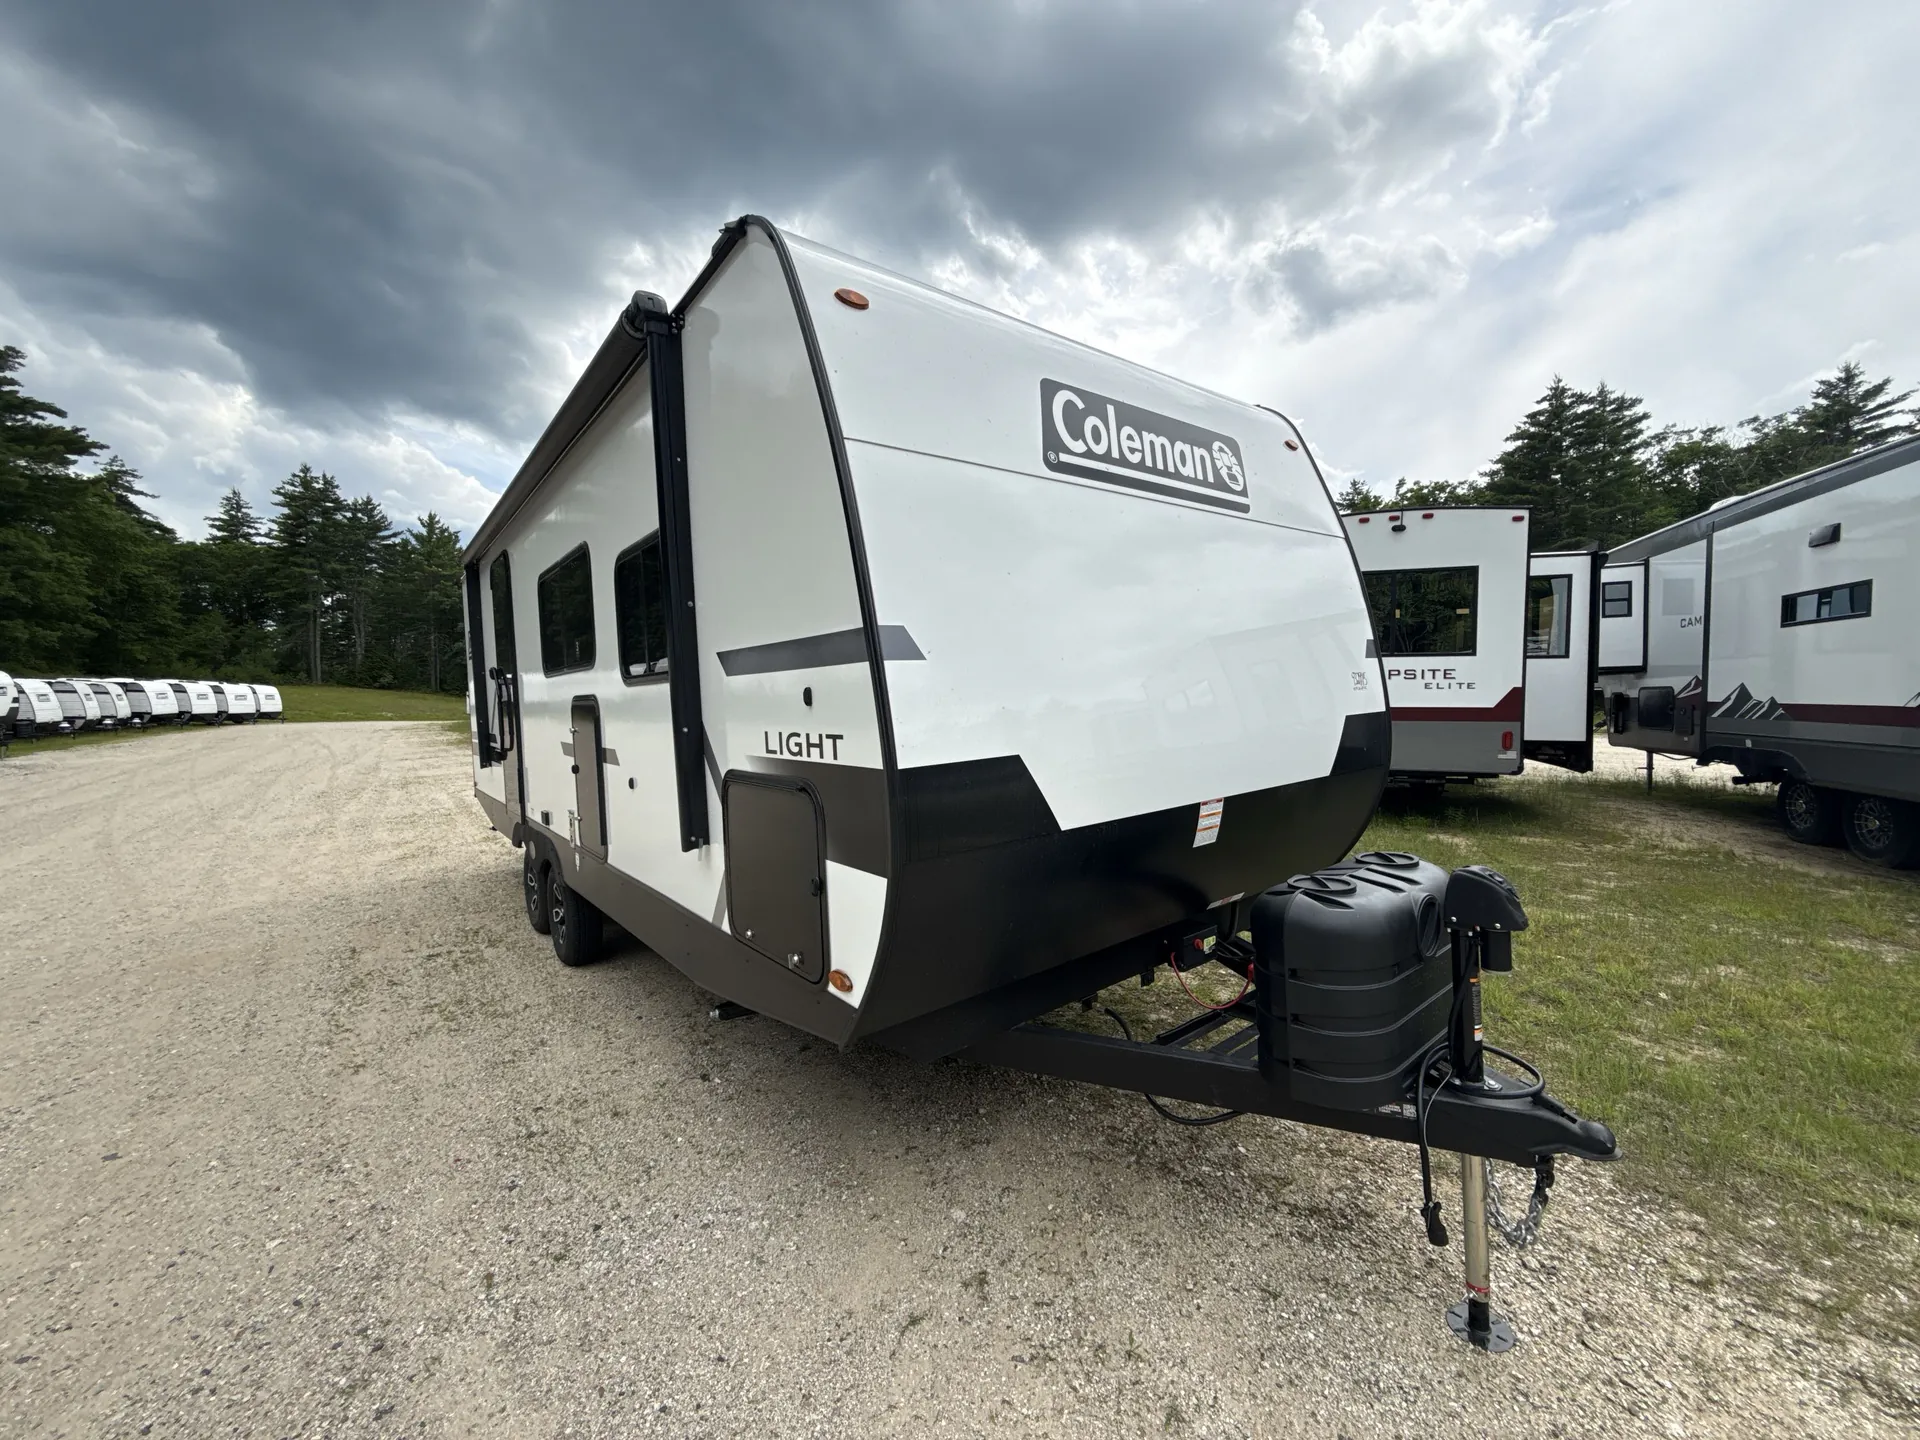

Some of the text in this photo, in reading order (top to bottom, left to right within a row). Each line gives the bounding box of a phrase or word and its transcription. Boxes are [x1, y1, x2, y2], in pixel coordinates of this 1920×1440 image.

[1052, 389, 1215, 484] Coleman
[1680, 615, 1702, 628] CAM
[1387, 668, 1456, 680] PSITE
[1423, 682, 1476, 690] ELITE
[764, 731, 844, 761] LIGHT
